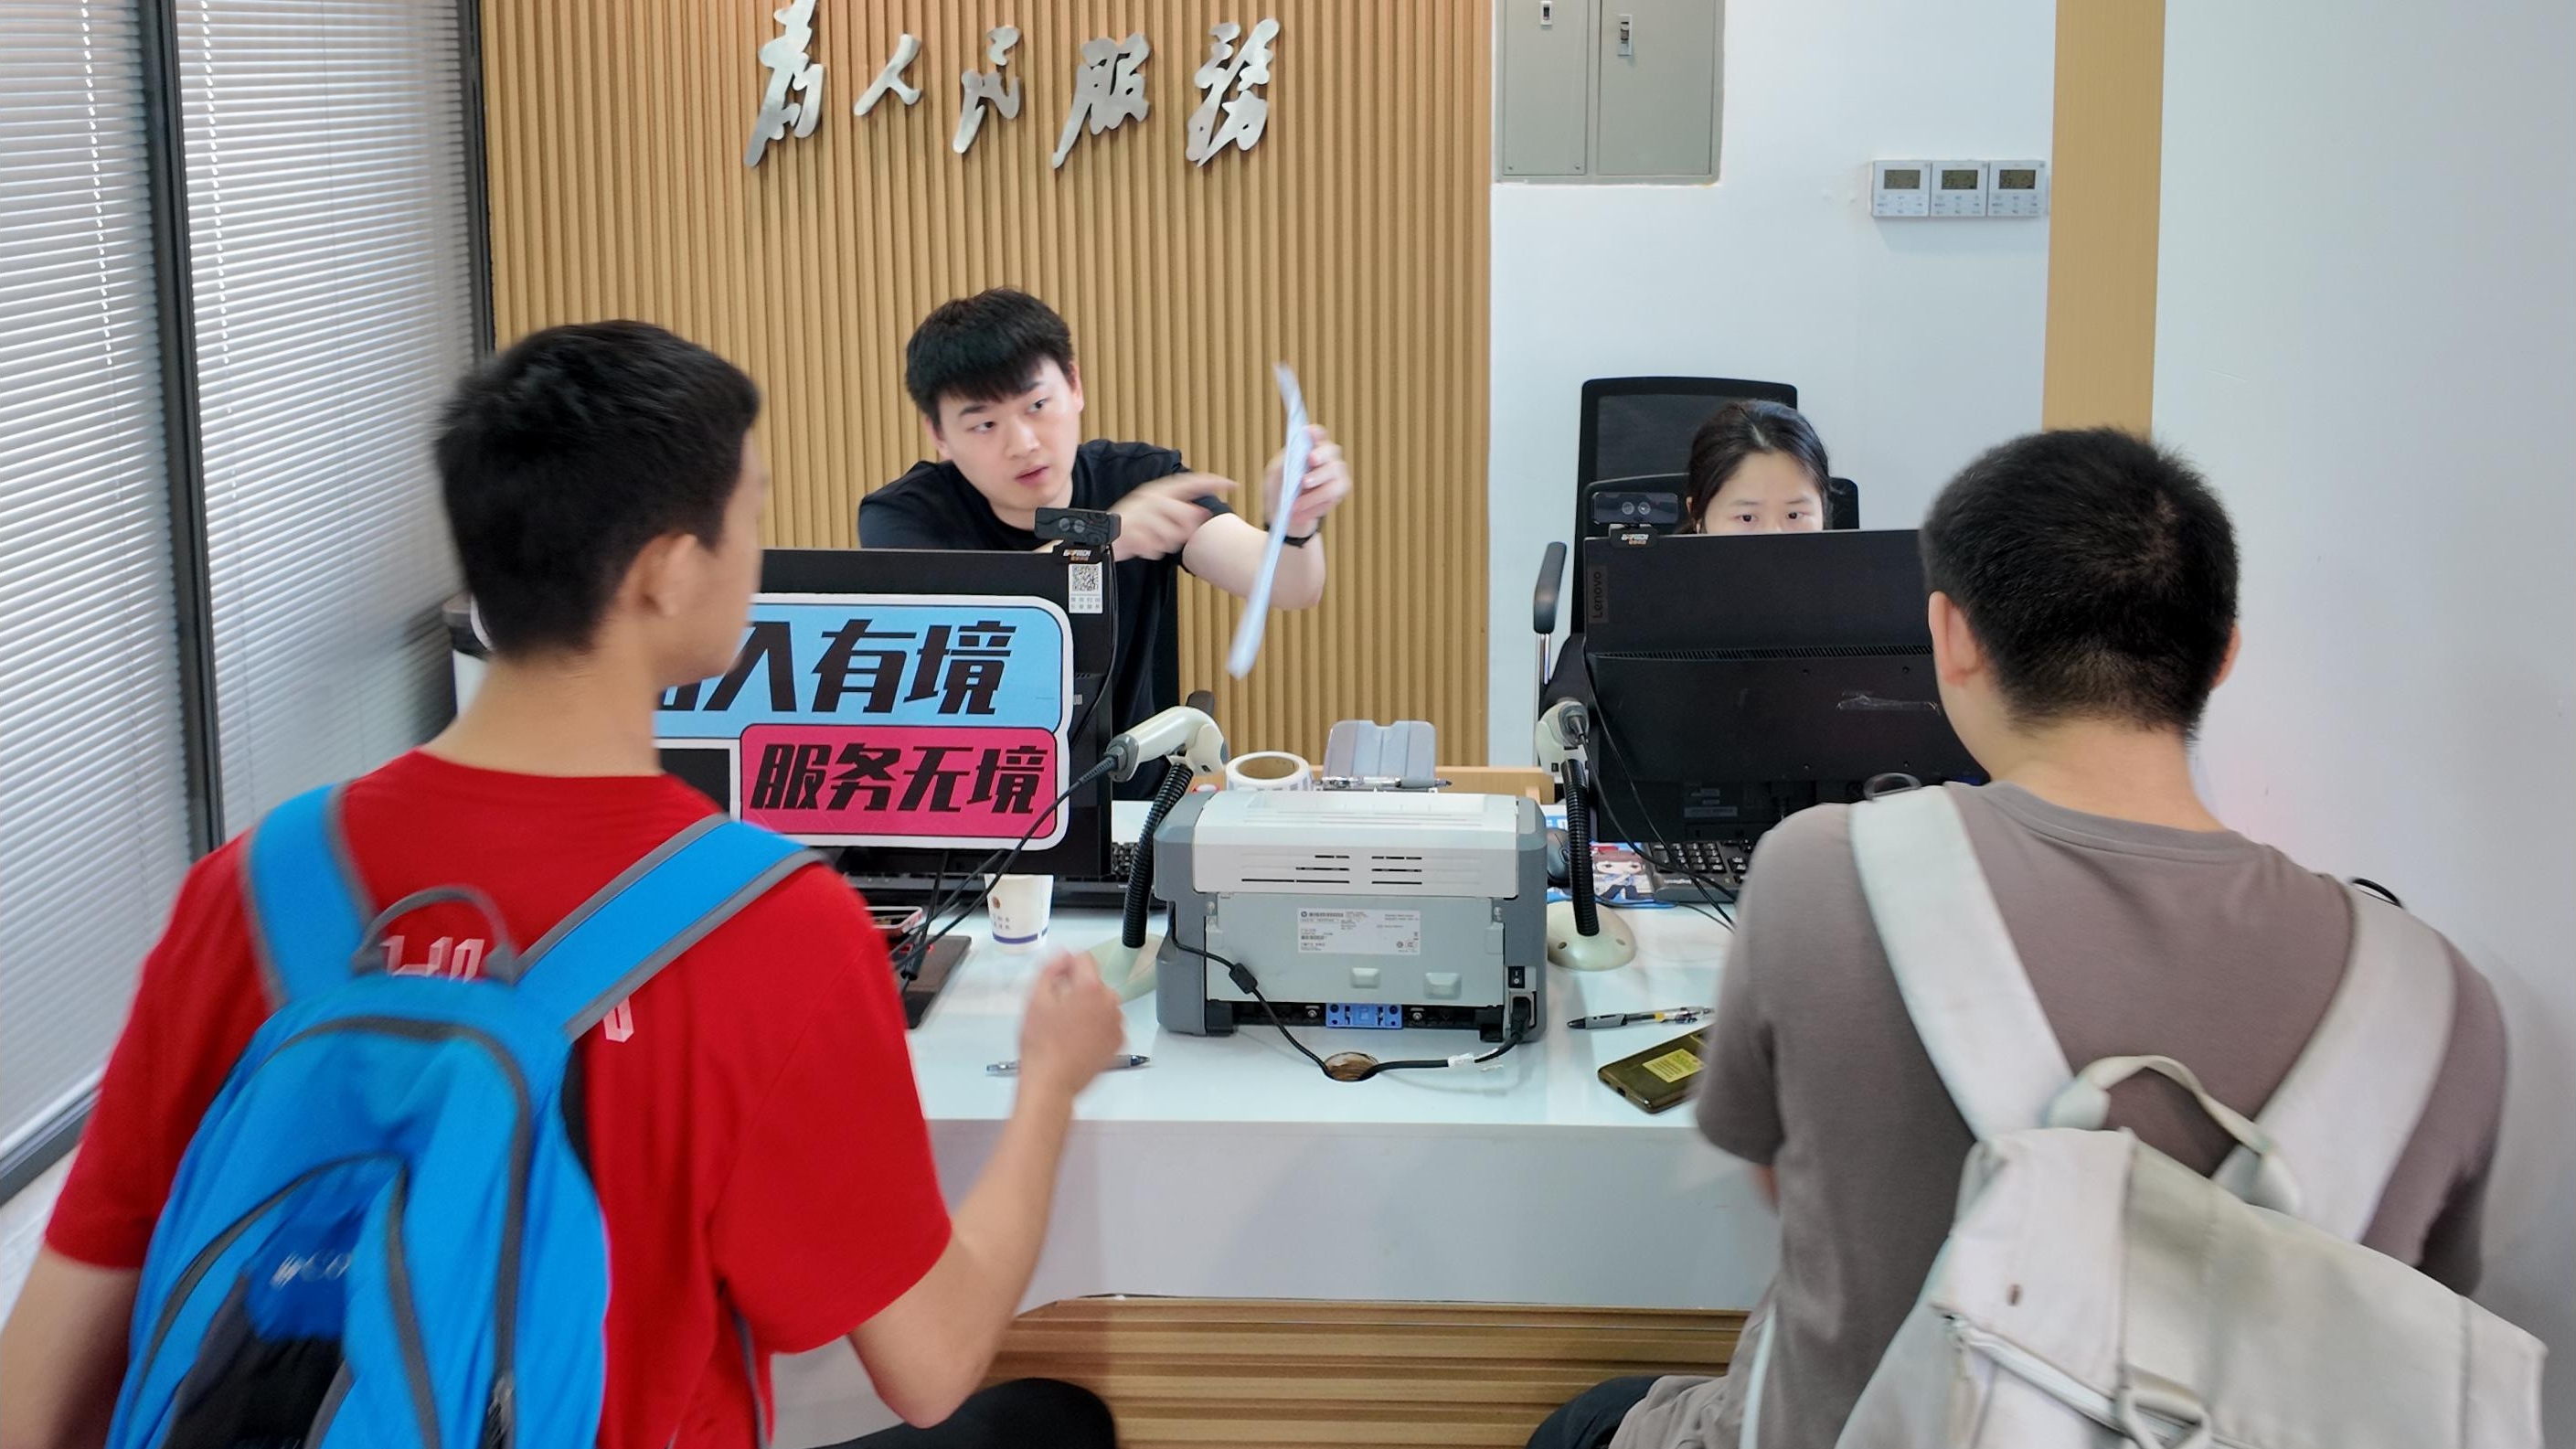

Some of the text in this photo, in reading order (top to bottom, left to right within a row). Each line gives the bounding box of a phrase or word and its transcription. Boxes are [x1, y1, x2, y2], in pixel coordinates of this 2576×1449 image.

[1592, 571, 1604, 620] Lenovo
[656, 619, 1017, 715] 入有境
[750, 742, 1048, 815] 服务无境
